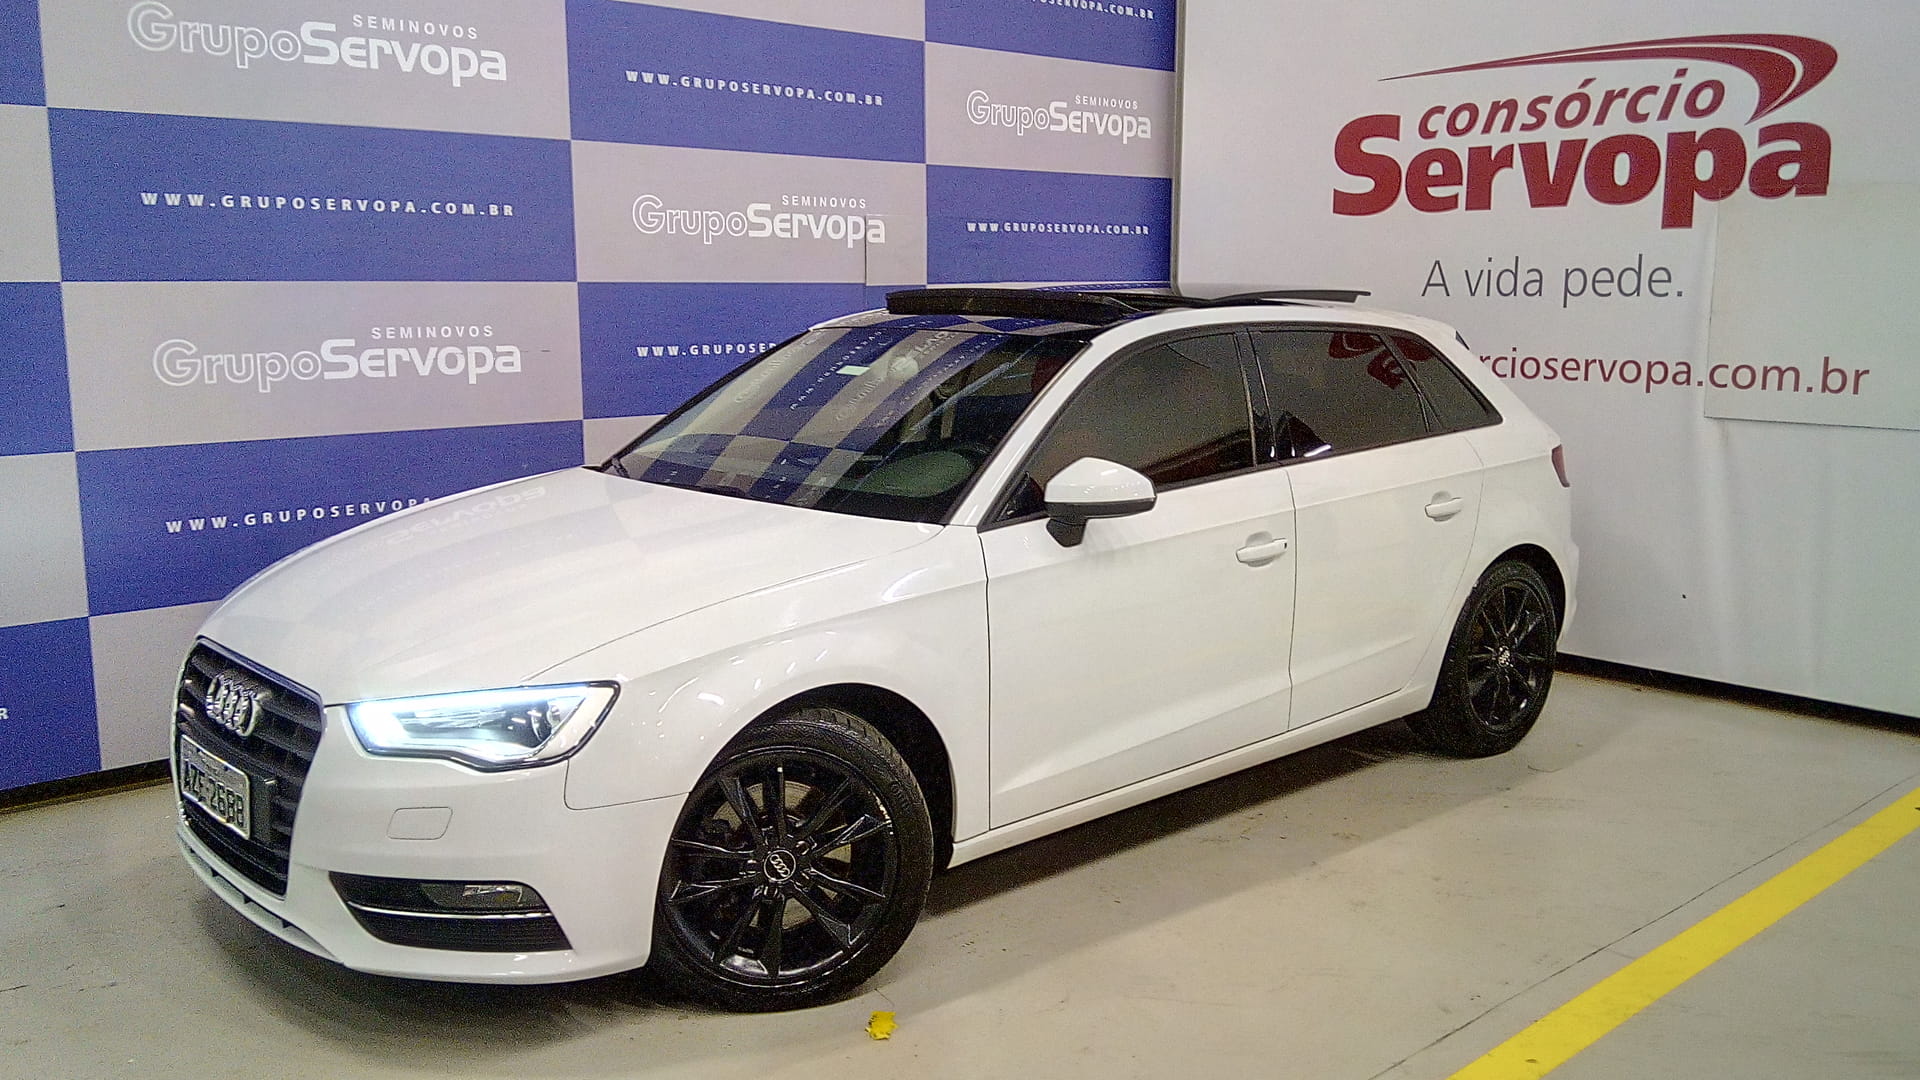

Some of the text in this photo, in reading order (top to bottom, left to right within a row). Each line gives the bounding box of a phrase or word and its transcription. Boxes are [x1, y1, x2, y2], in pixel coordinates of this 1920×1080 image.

[352, 14, 478, 40] SEMINOVOS
[625, 70, 883, 106] WWW.GRUPOSERVOPA.COM.BR
[1075, 95, 1138, 110] SEMINOVOS
[1418, 68, 1726, 141] consórcio
[1332, 114, 1833, 230] Servopa
[141, 192, 514, 216] WWW.GRUPOSERVOPA.COM.BR
[782, 194, 866, 209] SEMINOVOS
[1421, 254, 1683, 307] A vida pede.
[371, 325, 494, 339] SEMINOVOS
